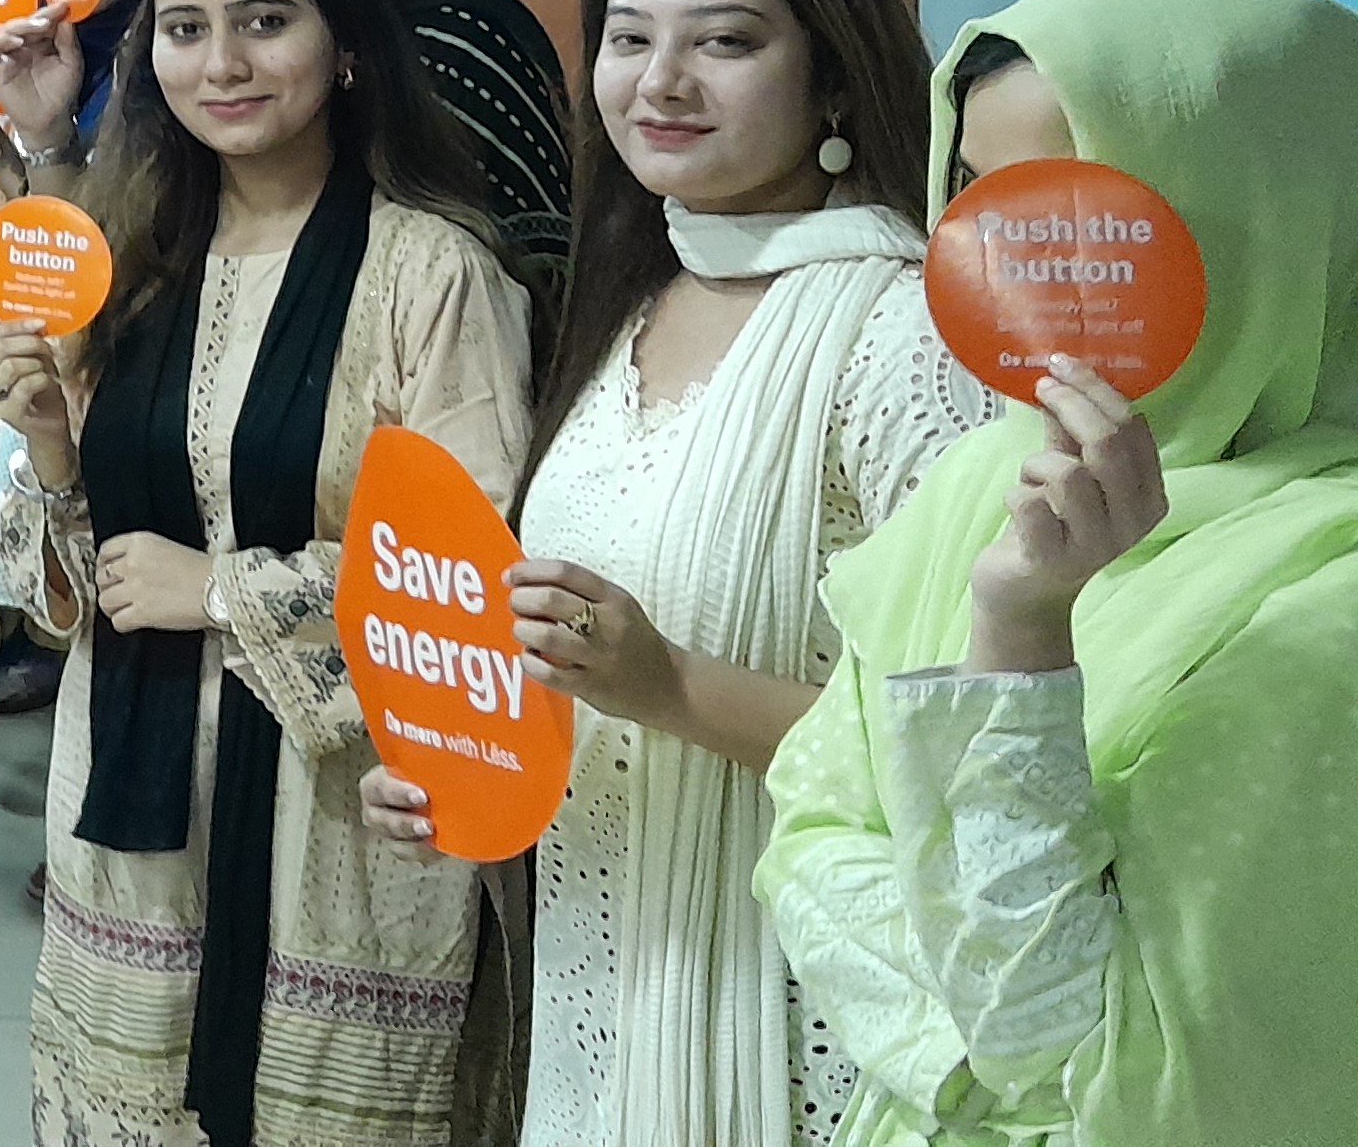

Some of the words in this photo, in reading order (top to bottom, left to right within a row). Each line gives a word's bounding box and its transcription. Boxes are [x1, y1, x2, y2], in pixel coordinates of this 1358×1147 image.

[1, 221, 49, 245] Push
[56, 230, 88, 252] the
[977, 211, 1075, 243] Push
[1086, 212, 1153, 244] the
[9, 244, 75, 272] button
[1000, 253, 1135, 284] button
[371, 520, 485, 615] Save
[364, 612, 524, 720] energy
[403, 720, 442, 749] more
[443, 731, 480, 760] with
